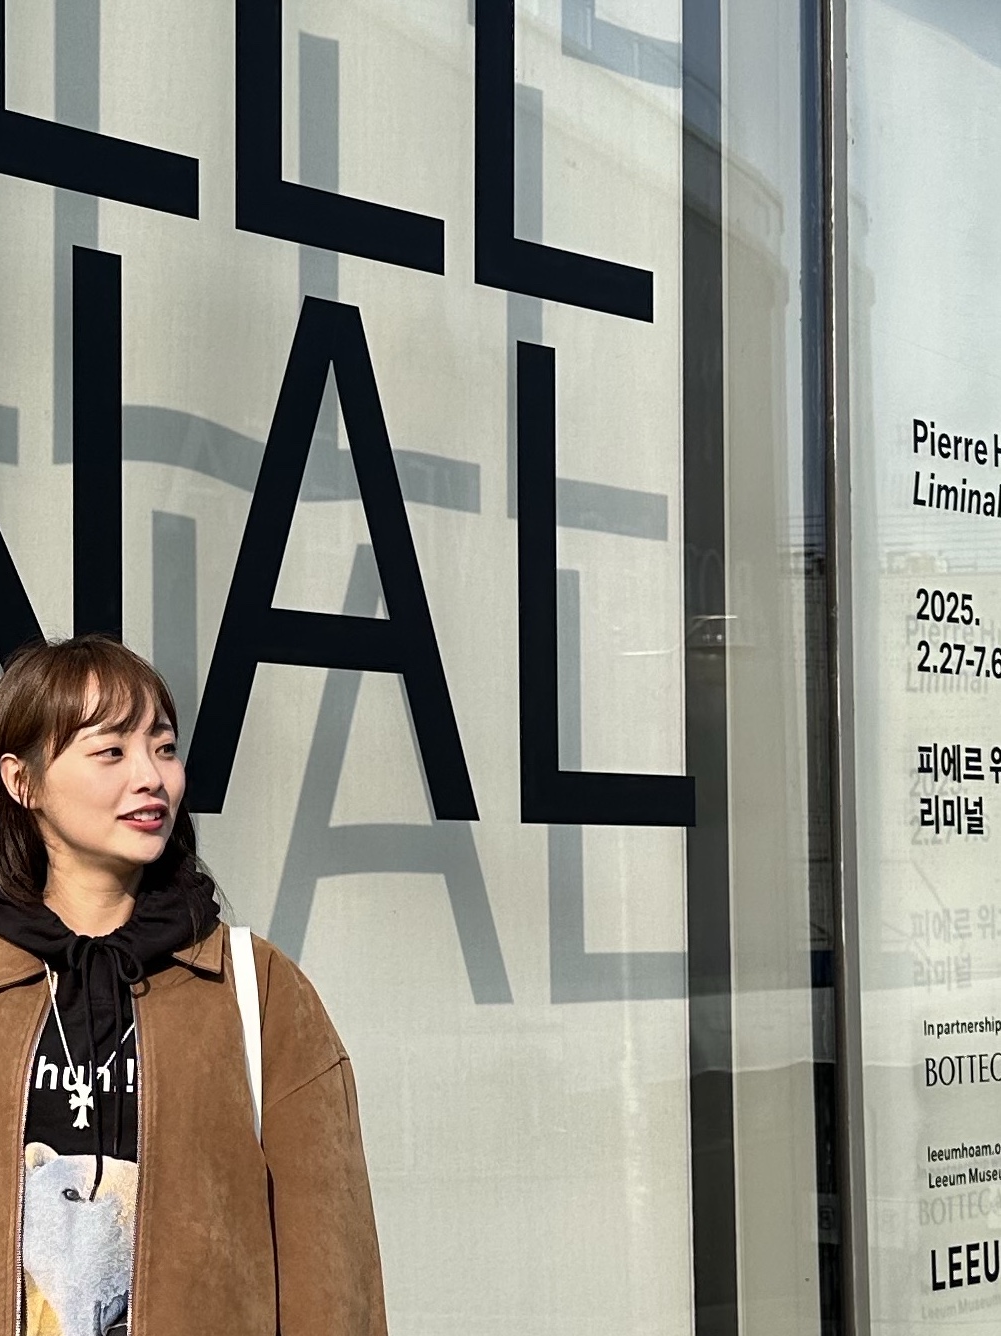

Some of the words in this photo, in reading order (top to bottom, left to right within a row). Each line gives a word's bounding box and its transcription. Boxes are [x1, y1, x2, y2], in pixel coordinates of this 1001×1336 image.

[912, 418, 988, 465] Pierre
[912, 471, 1001, 518] Liminal
[916, 588, 980, 626] 2025.
[917, 640, 1001, 679] 2.27-7.6
[917, 742, 985, 784] 피에르
[920, 794, 984, 836] 리미널
[923, 1019, 935, 1036] In
[936, 1016, 1001, 1039] partnership
[926, 1142, 1001, 1163] leeumhoam.o
[928, 1171, 967, 1189] Leeum
[930, 1239, 1001, 1292] LEEU
